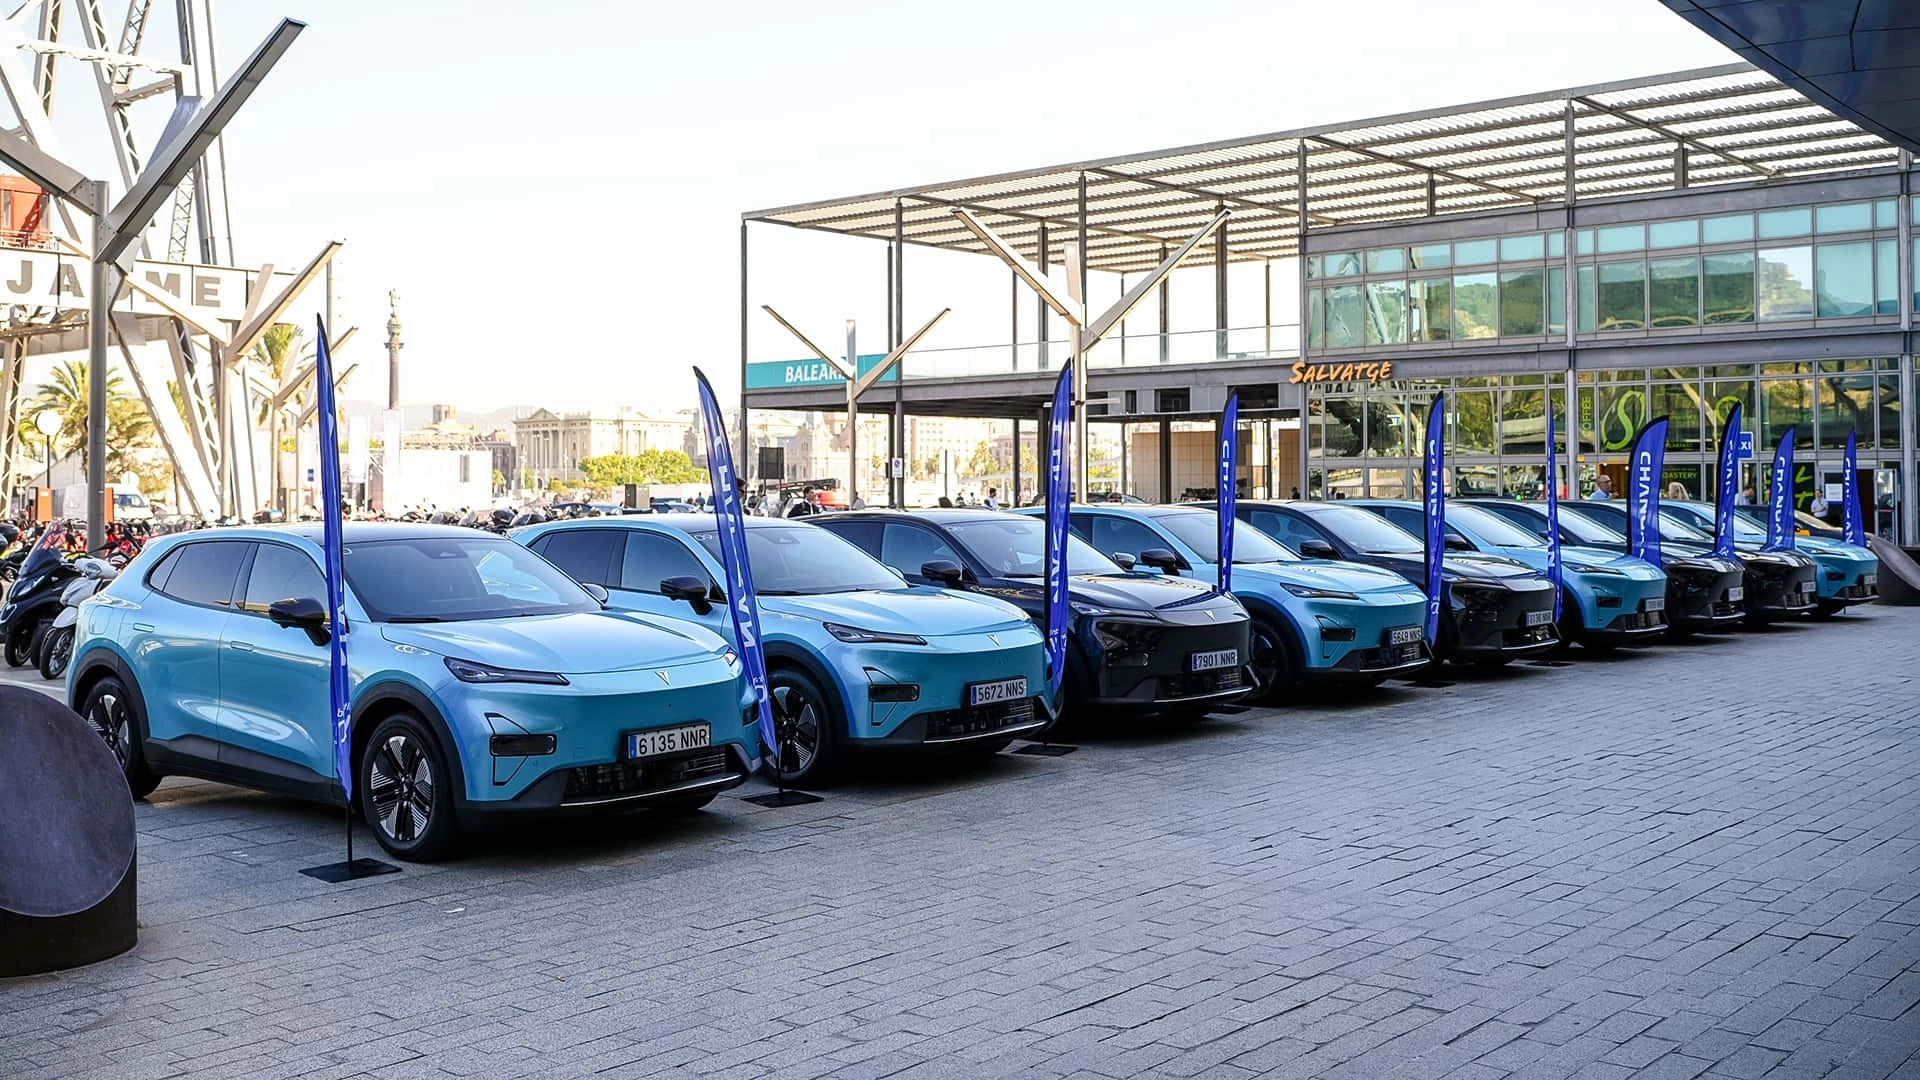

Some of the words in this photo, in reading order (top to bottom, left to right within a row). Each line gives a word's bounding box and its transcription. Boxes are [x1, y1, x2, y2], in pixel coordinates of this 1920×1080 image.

[6, 260, 221, 307] JAME
[1197, 653, 1218, 668] 7901
[1220, 651, 1236, 665] NNR
[978, 684, 1003, 701] 5672
[1005, 681, 1024, 697] NNS
[638, 733, 676, 755] 6135
[680, 728, 708, 748] NNR
